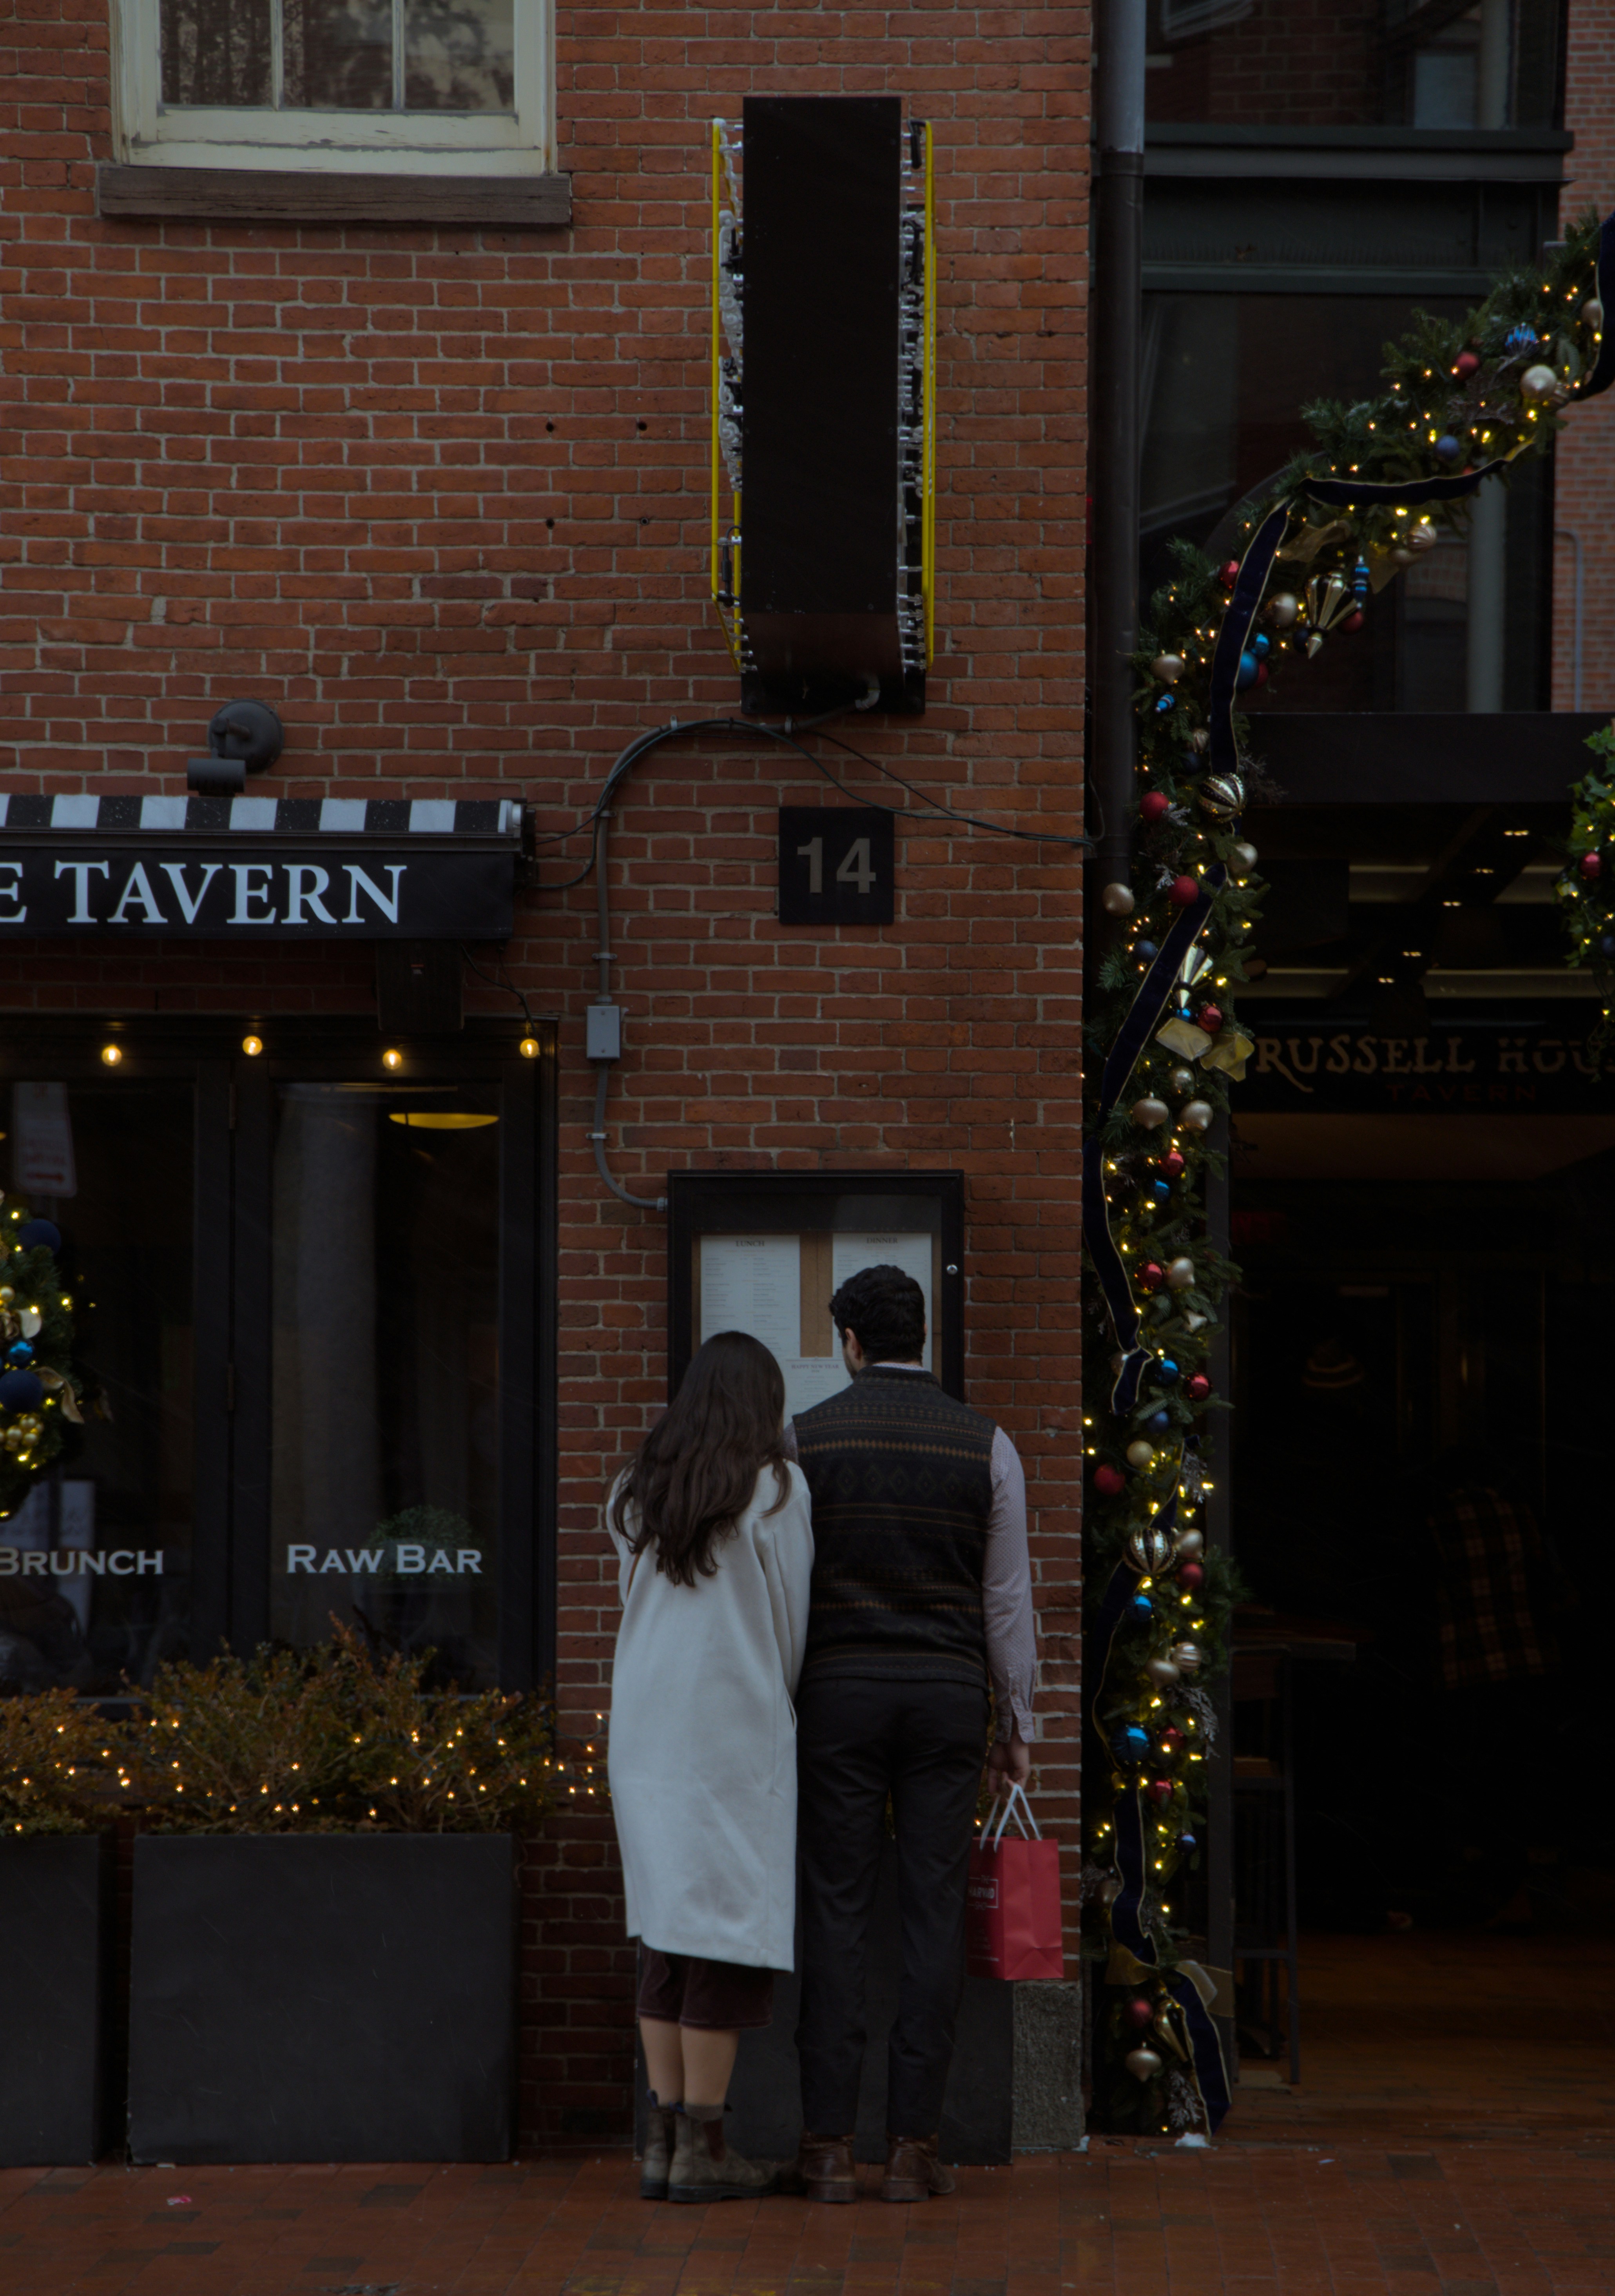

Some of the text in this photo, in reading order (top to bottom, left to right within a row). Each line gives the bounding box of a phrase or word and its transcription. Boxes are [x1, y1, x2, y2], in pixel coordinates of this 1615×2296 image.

[54, 860, 408, 925] TAVERN
[797, 837, 877, 894] 14
[1255, 1034, 1615, 1093] RUSSELL HOU
[1385, 1084, 1537, 1103] TAVERN
[286, 1543, 483, 1574] RAW BAR
